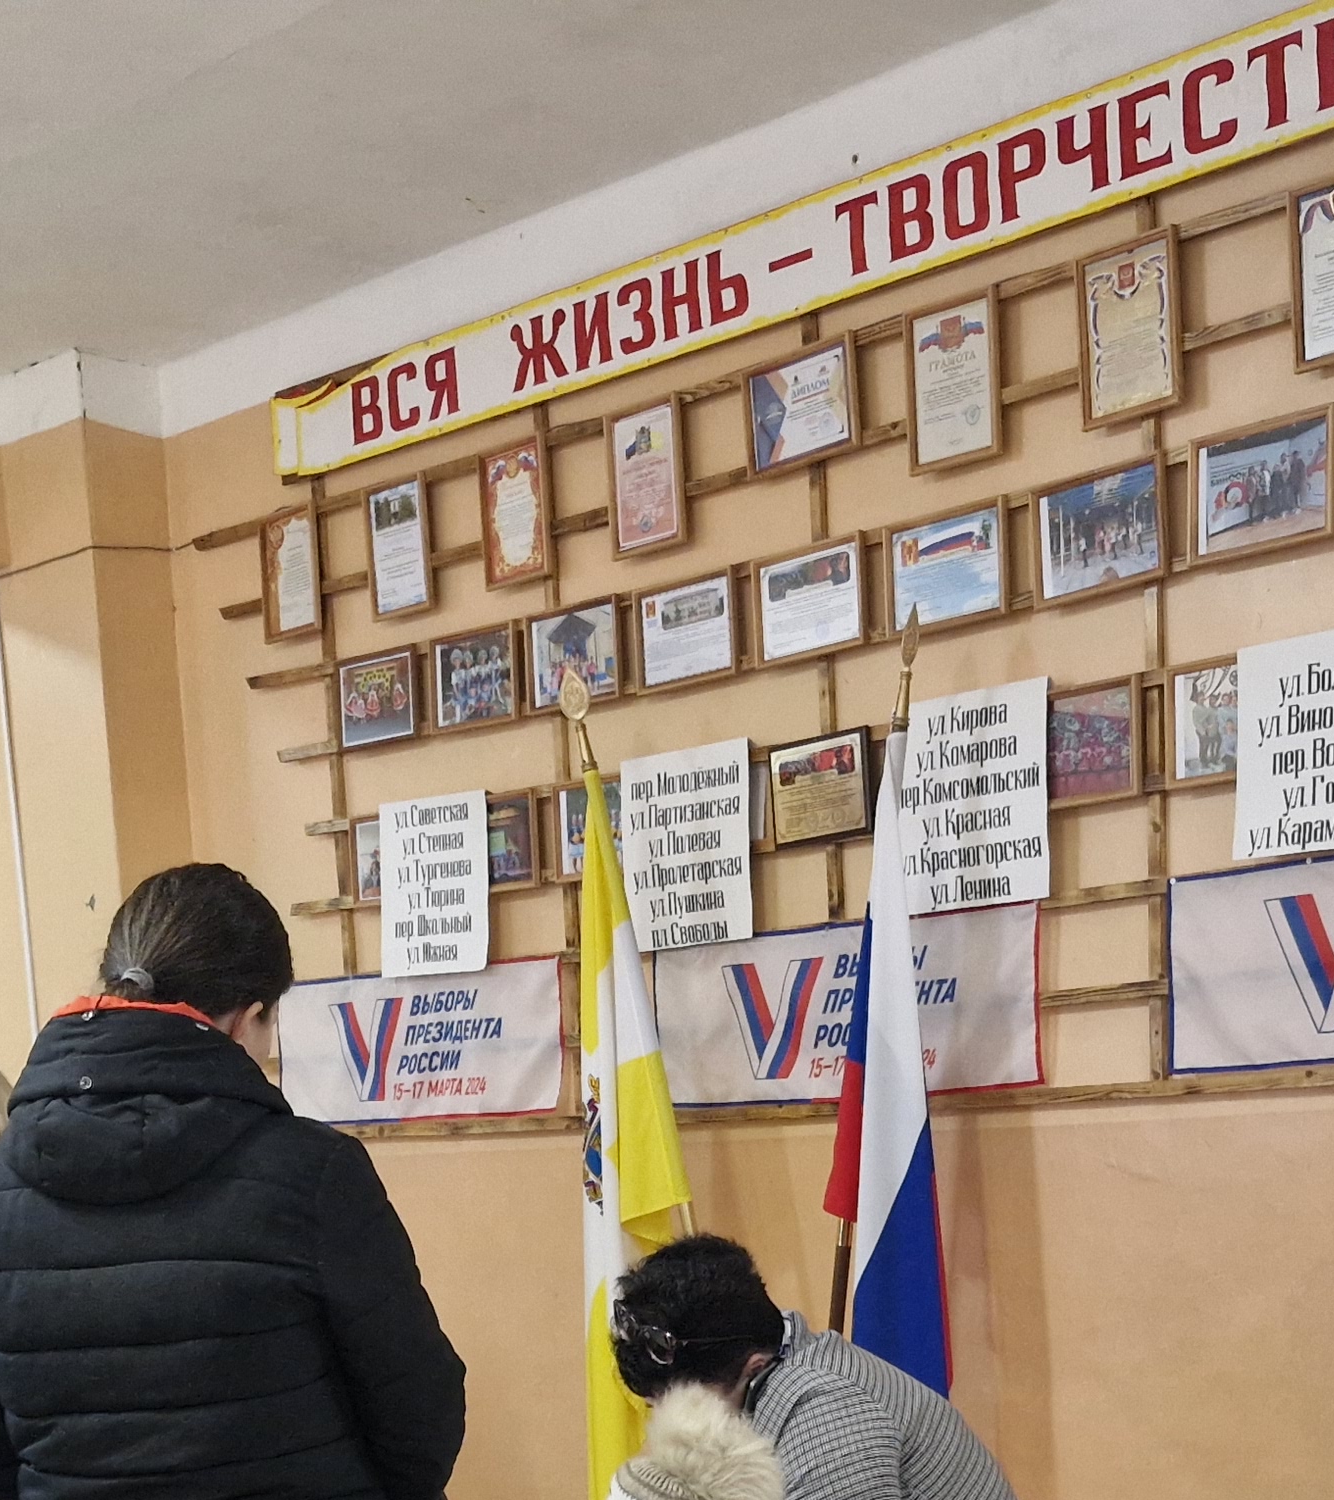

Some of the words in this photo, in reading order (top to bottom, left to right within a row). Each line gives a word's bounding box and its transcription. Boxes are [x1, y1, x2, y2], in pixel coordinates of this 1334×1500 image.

[351, 347, 461, 446] ВСЯ
[511, 250, 750, 393] ЖИЗНЬ
[950, 703, 1008, 735] Кирова
[939, 735, 1017, 767] Комарова
[410, 802, 469, 827] Советская
[648, 795, 740, 830] Партизанская
[945, 805, 1011, 840] Красная
[418, 832, 464, 854] Степная
[667, 829, 721, 856] Полевая
[920, 836, 1042, 877] Красногорская
[413, 859, 472, 886] Тургенева
[651, 856, 742, 892] Пролетарская
[424, 886, 465, 912] Тюрина
[953, 875, 1011, 902] Ленина
[667, 890, 725, 919] Пушкина
[417, 911, 471, 936] Школьный
[670, 920, 729, 945] Свободы
[409, 989, 478, 1016] ВЫБОРЫ
[404, 1017, 503, 1046] ПРЕЗИДЕНТА
[396, 1049, 461, 1076] РОССИИ
[427, 1077, 463, 1098] МАРТА
[465, 1076, 486, 1096] 2024
